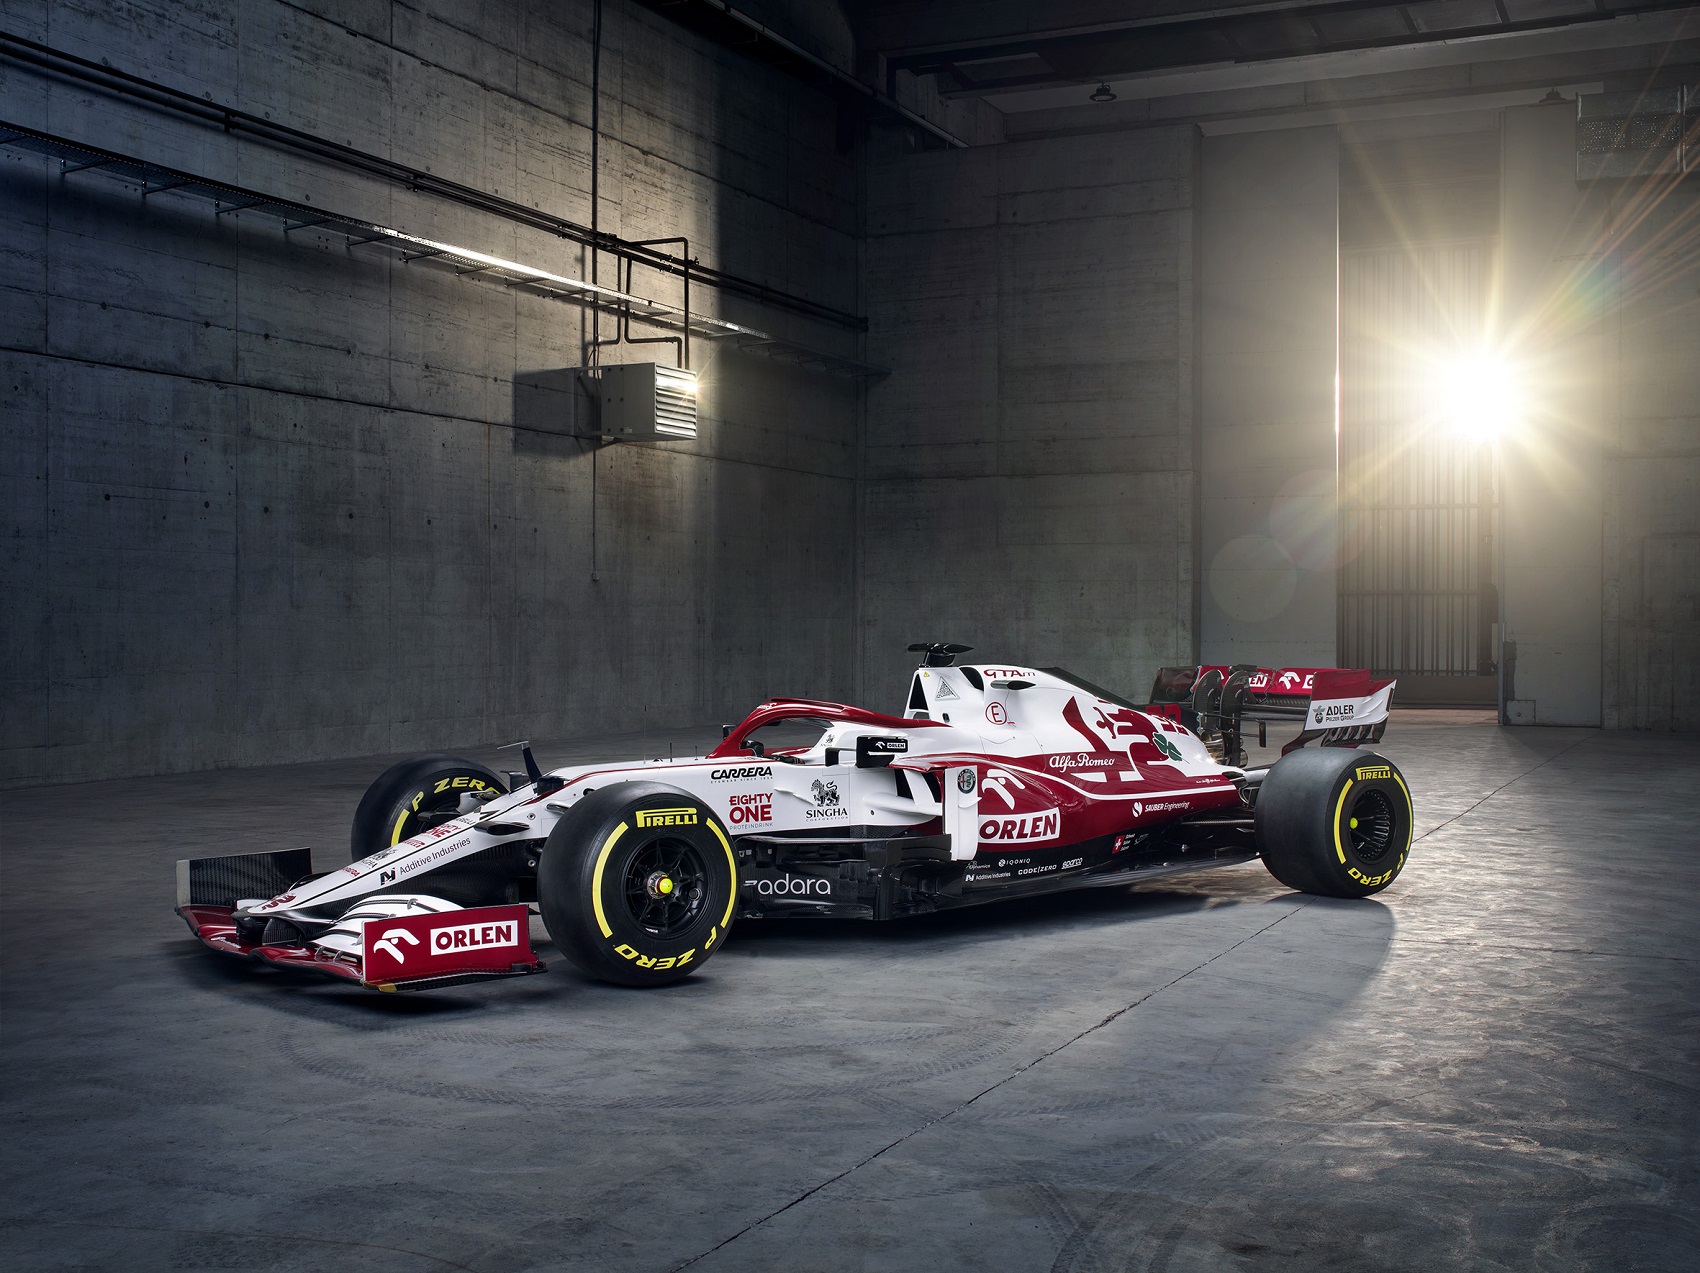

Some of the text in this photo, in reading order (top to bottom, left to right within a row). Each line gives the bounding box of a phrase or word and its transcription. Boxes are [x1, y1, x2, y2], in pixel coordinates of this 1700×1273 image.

[1326, 704, 1354, 716] ADLER
[711, 766, 773, 780] CARRERA
[1050, 753, 1115, 773] Alfa Romeo
[1355, 765, 1391, 781] PIRELLI
[412, 791, 424, 812] P
[729, 793, 773, 806] EIGHTY
[1144, 801, 1190, 813] SAUBER Engineering
[635, 807, 698, 828] PIRELLI
[729, 804, 773, 824] ONE
[806, 807, 848, 819] SINGHA
[730, 822, 774, 830] PROTEINDRINK
[979, 813, 1057, 840] ORLEN
[400, 855, 432, 875] Additive
[432, 837, 471, 860] Industries
[1347, 867, 1393, 887] ZERO
[435, 924, 512, 949] ORLEN
[614, 926, 717, 970] P ZERO
